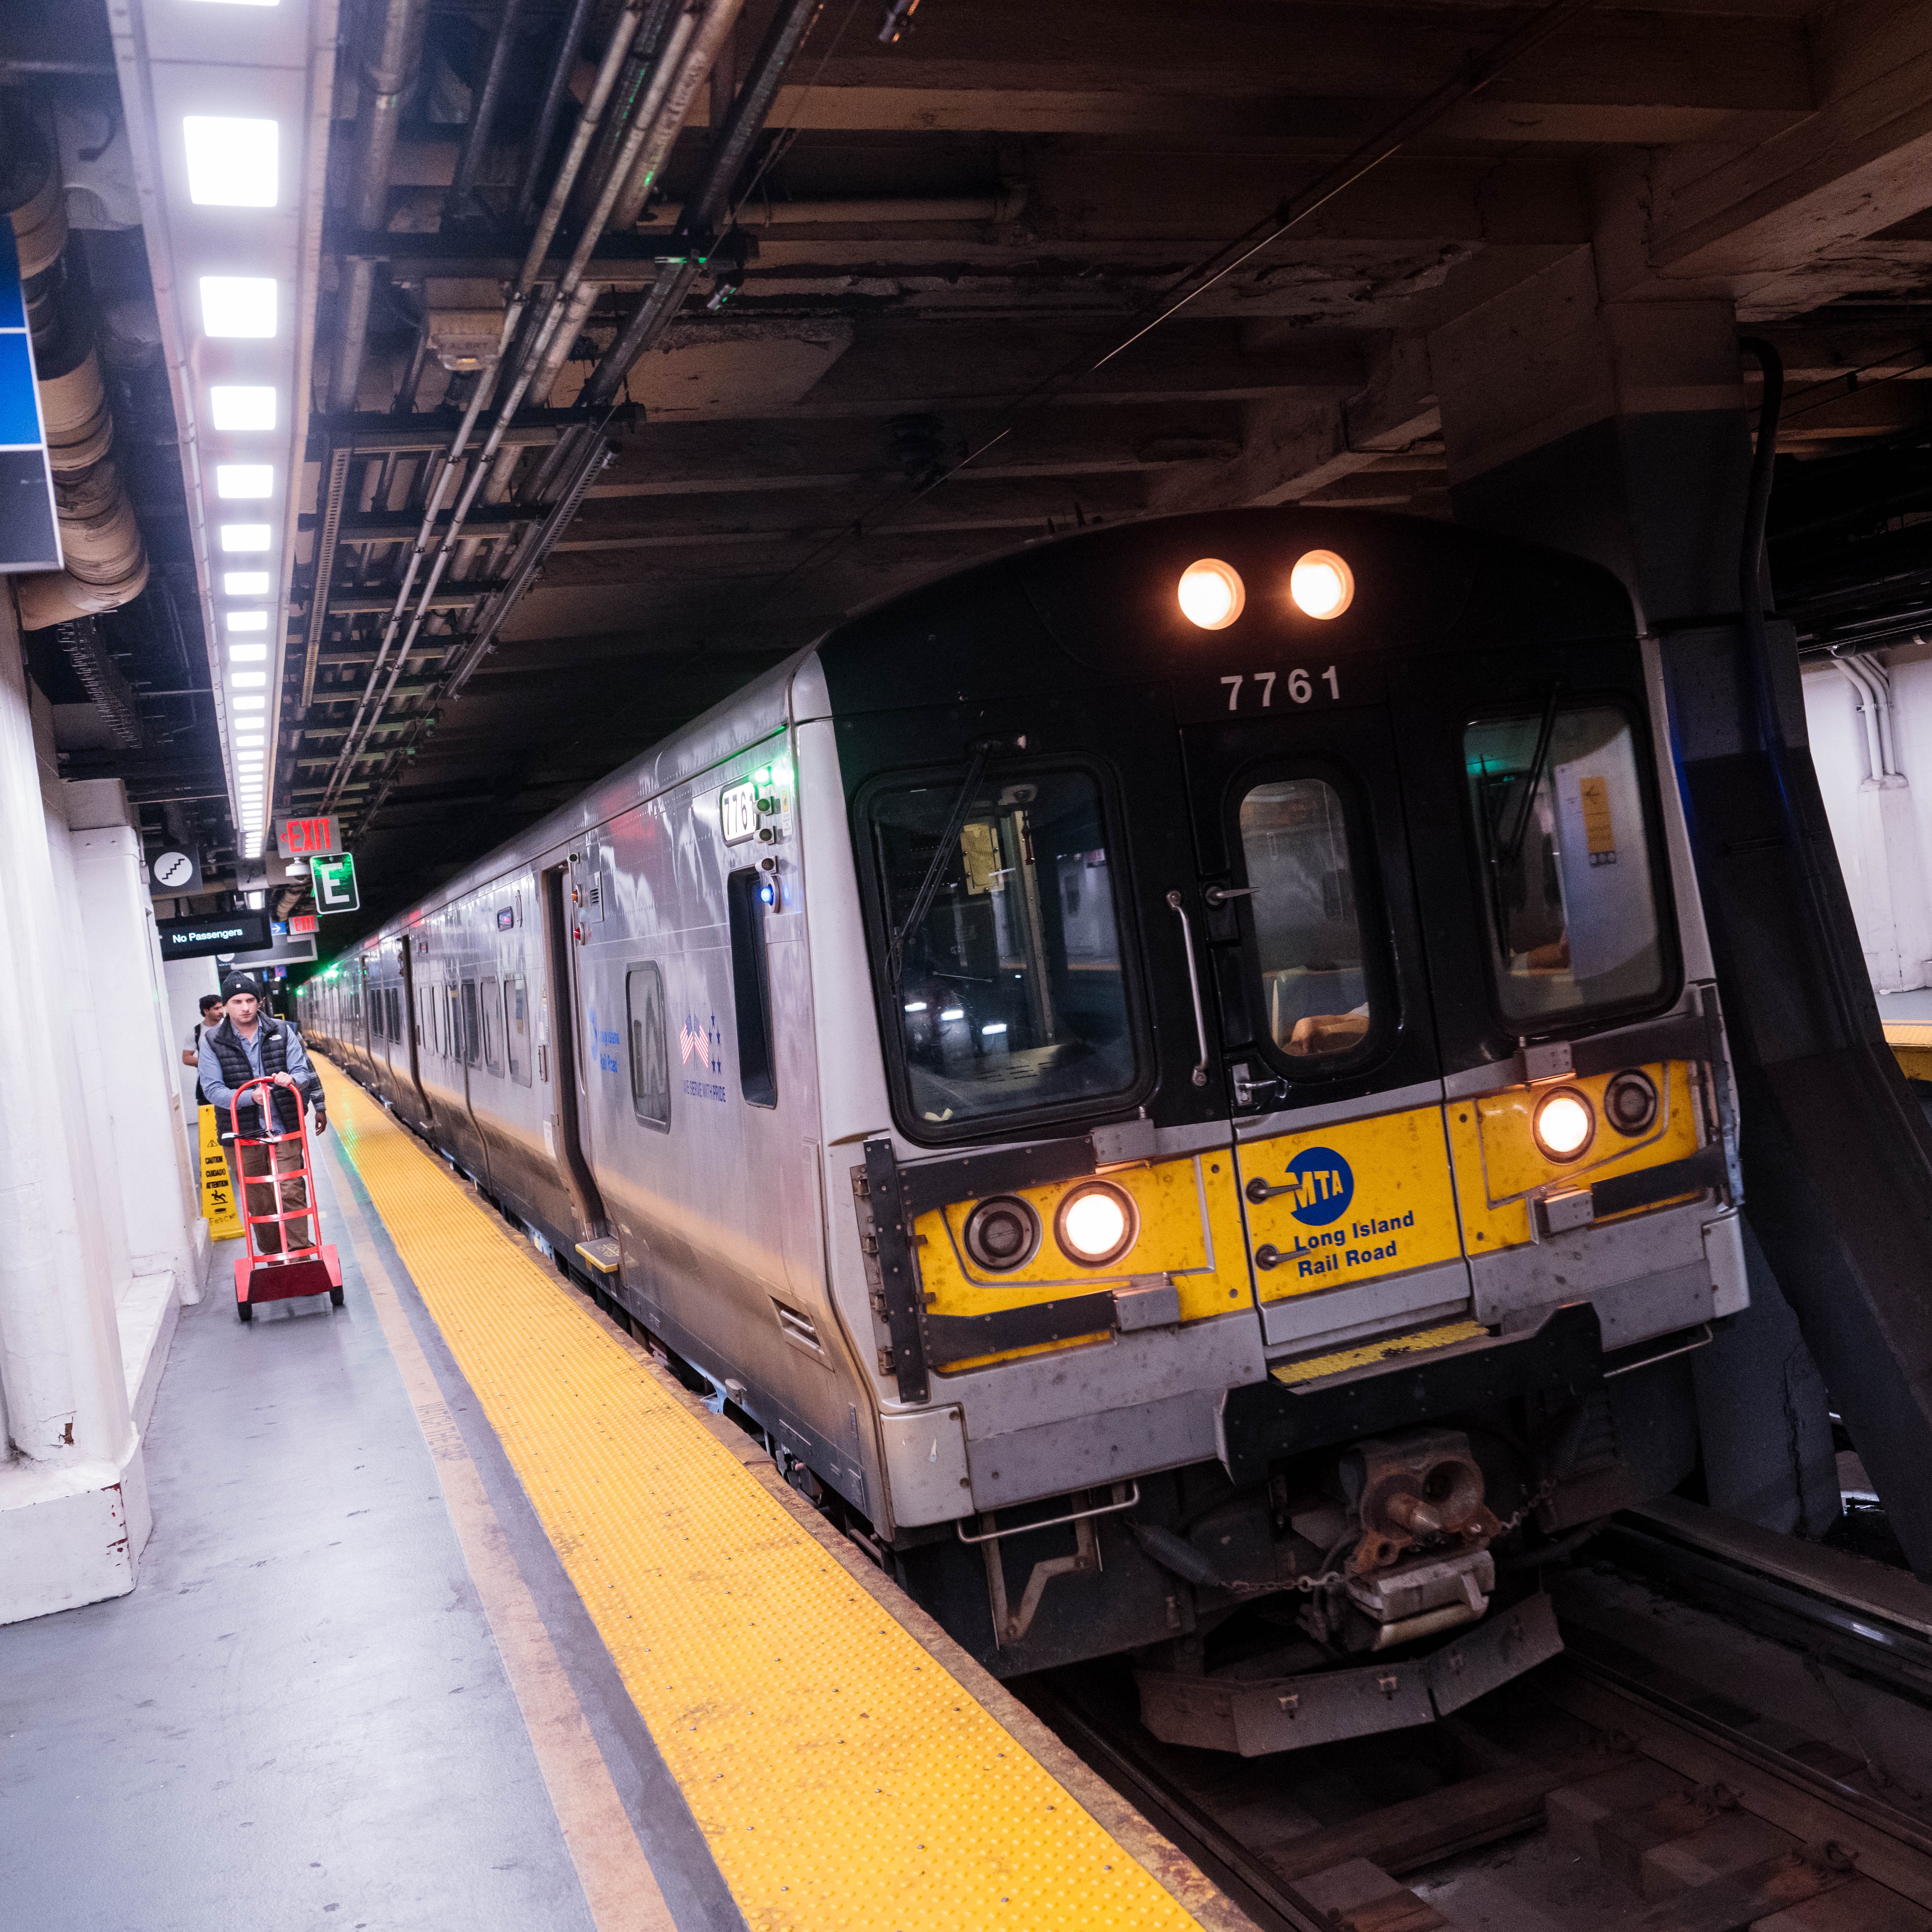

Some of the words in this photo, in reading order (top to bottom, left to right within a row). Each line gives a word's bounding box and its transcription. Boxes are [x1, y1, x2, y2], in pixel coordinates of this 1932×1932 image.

[1220, 665, 1340, 711] 7761
[724, 790, 755, 835] 7761
[286, 818, 331, 853] EXIT
[321, 862, 350, 904] E
[172, 934, 187, 943] No
[188, 929, 243, 941] Passengers
[293, 915, 315, 932] EXIT
[690, 1080, 702, 1098] SERVE
[703, 1083, 713, 1100] WITH
[713, 1085, 726, 1102] PRIDE
[205, 1156, 223, 1165] CAUTION
[206, 1169, 226, 1177] CUIDADO
[1285, 1170, 1344, 1212] MTA
[1294, 1229, 1346, 1252] Long
[1352, 1210, 1415, 1239] Island
[1298, 1254, 1339, 1277] Rail
[1345, 1241, 1397, 1267] Road
